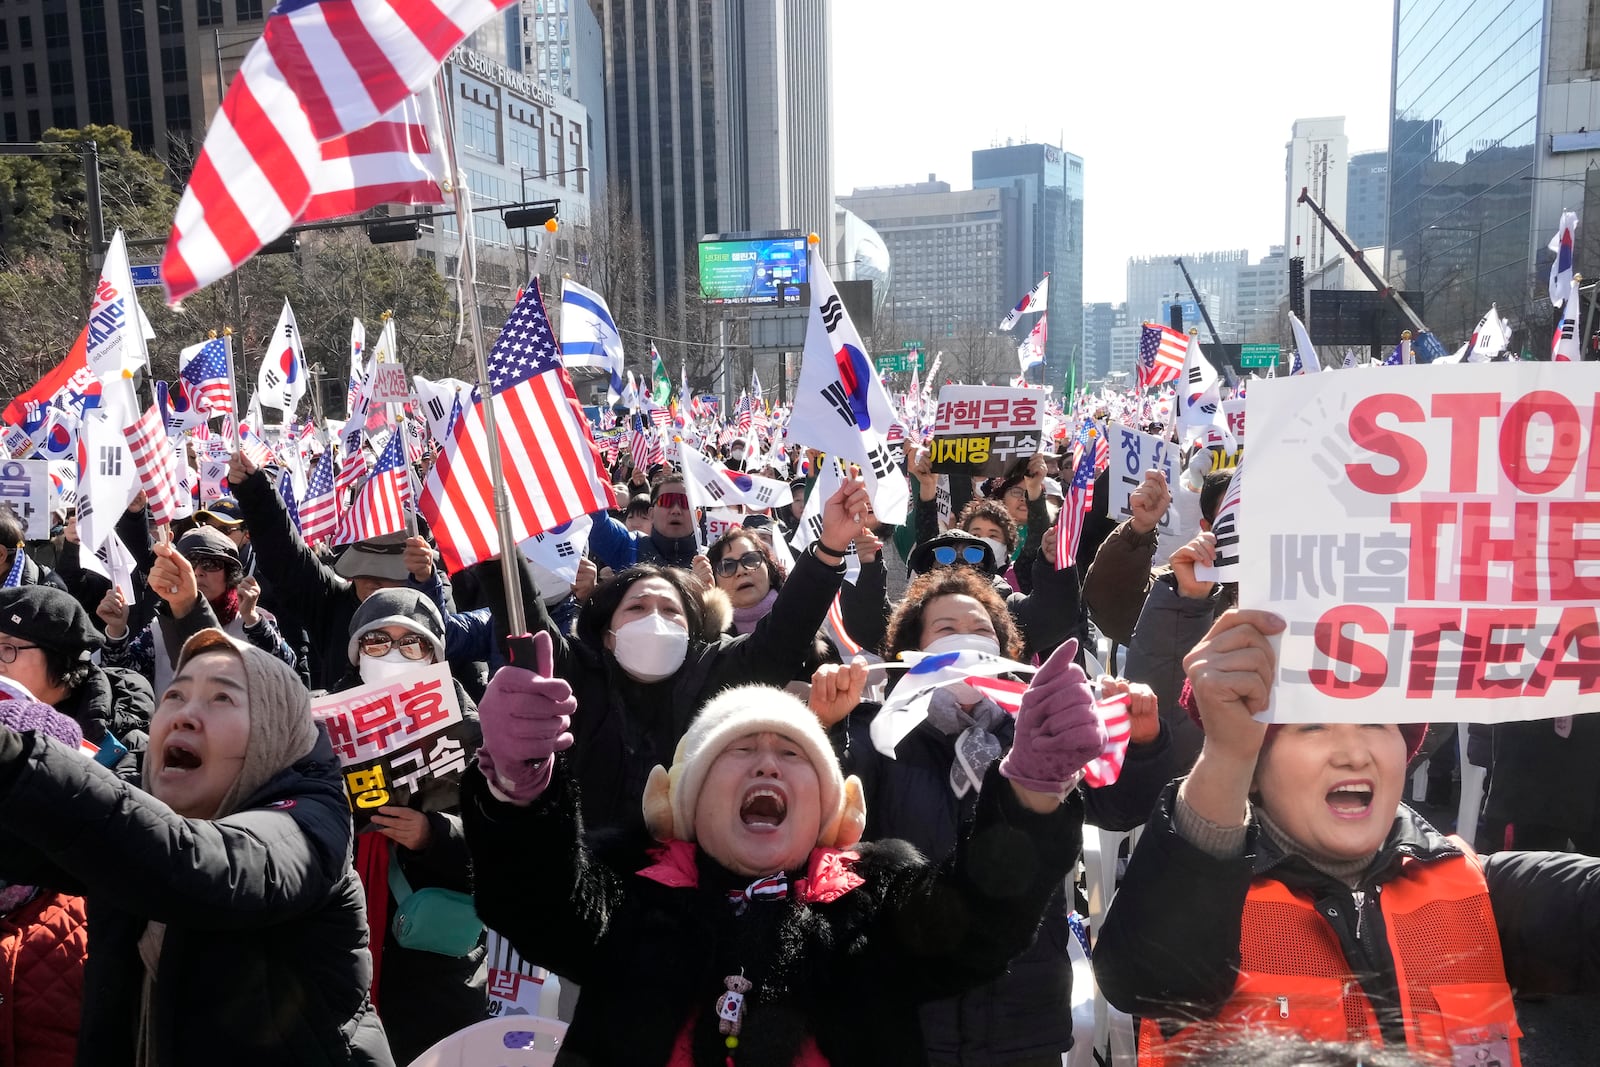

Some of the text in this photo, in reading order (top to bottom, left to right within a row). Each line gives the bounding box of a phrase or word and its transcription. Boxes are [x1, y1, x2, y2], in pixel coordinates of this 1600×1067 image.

[468, 50, 497, 79] SEOUL
[497, 64, 530, 96] FINANCE
[935, 397, 1037, 430] 탄핵무효
[930, 437, 991, 464] 이재명
[1345, 391, 1600, 495] STO
[1390, 501, 1600, 601] THE
[390, 736, 467, 795] 구속
